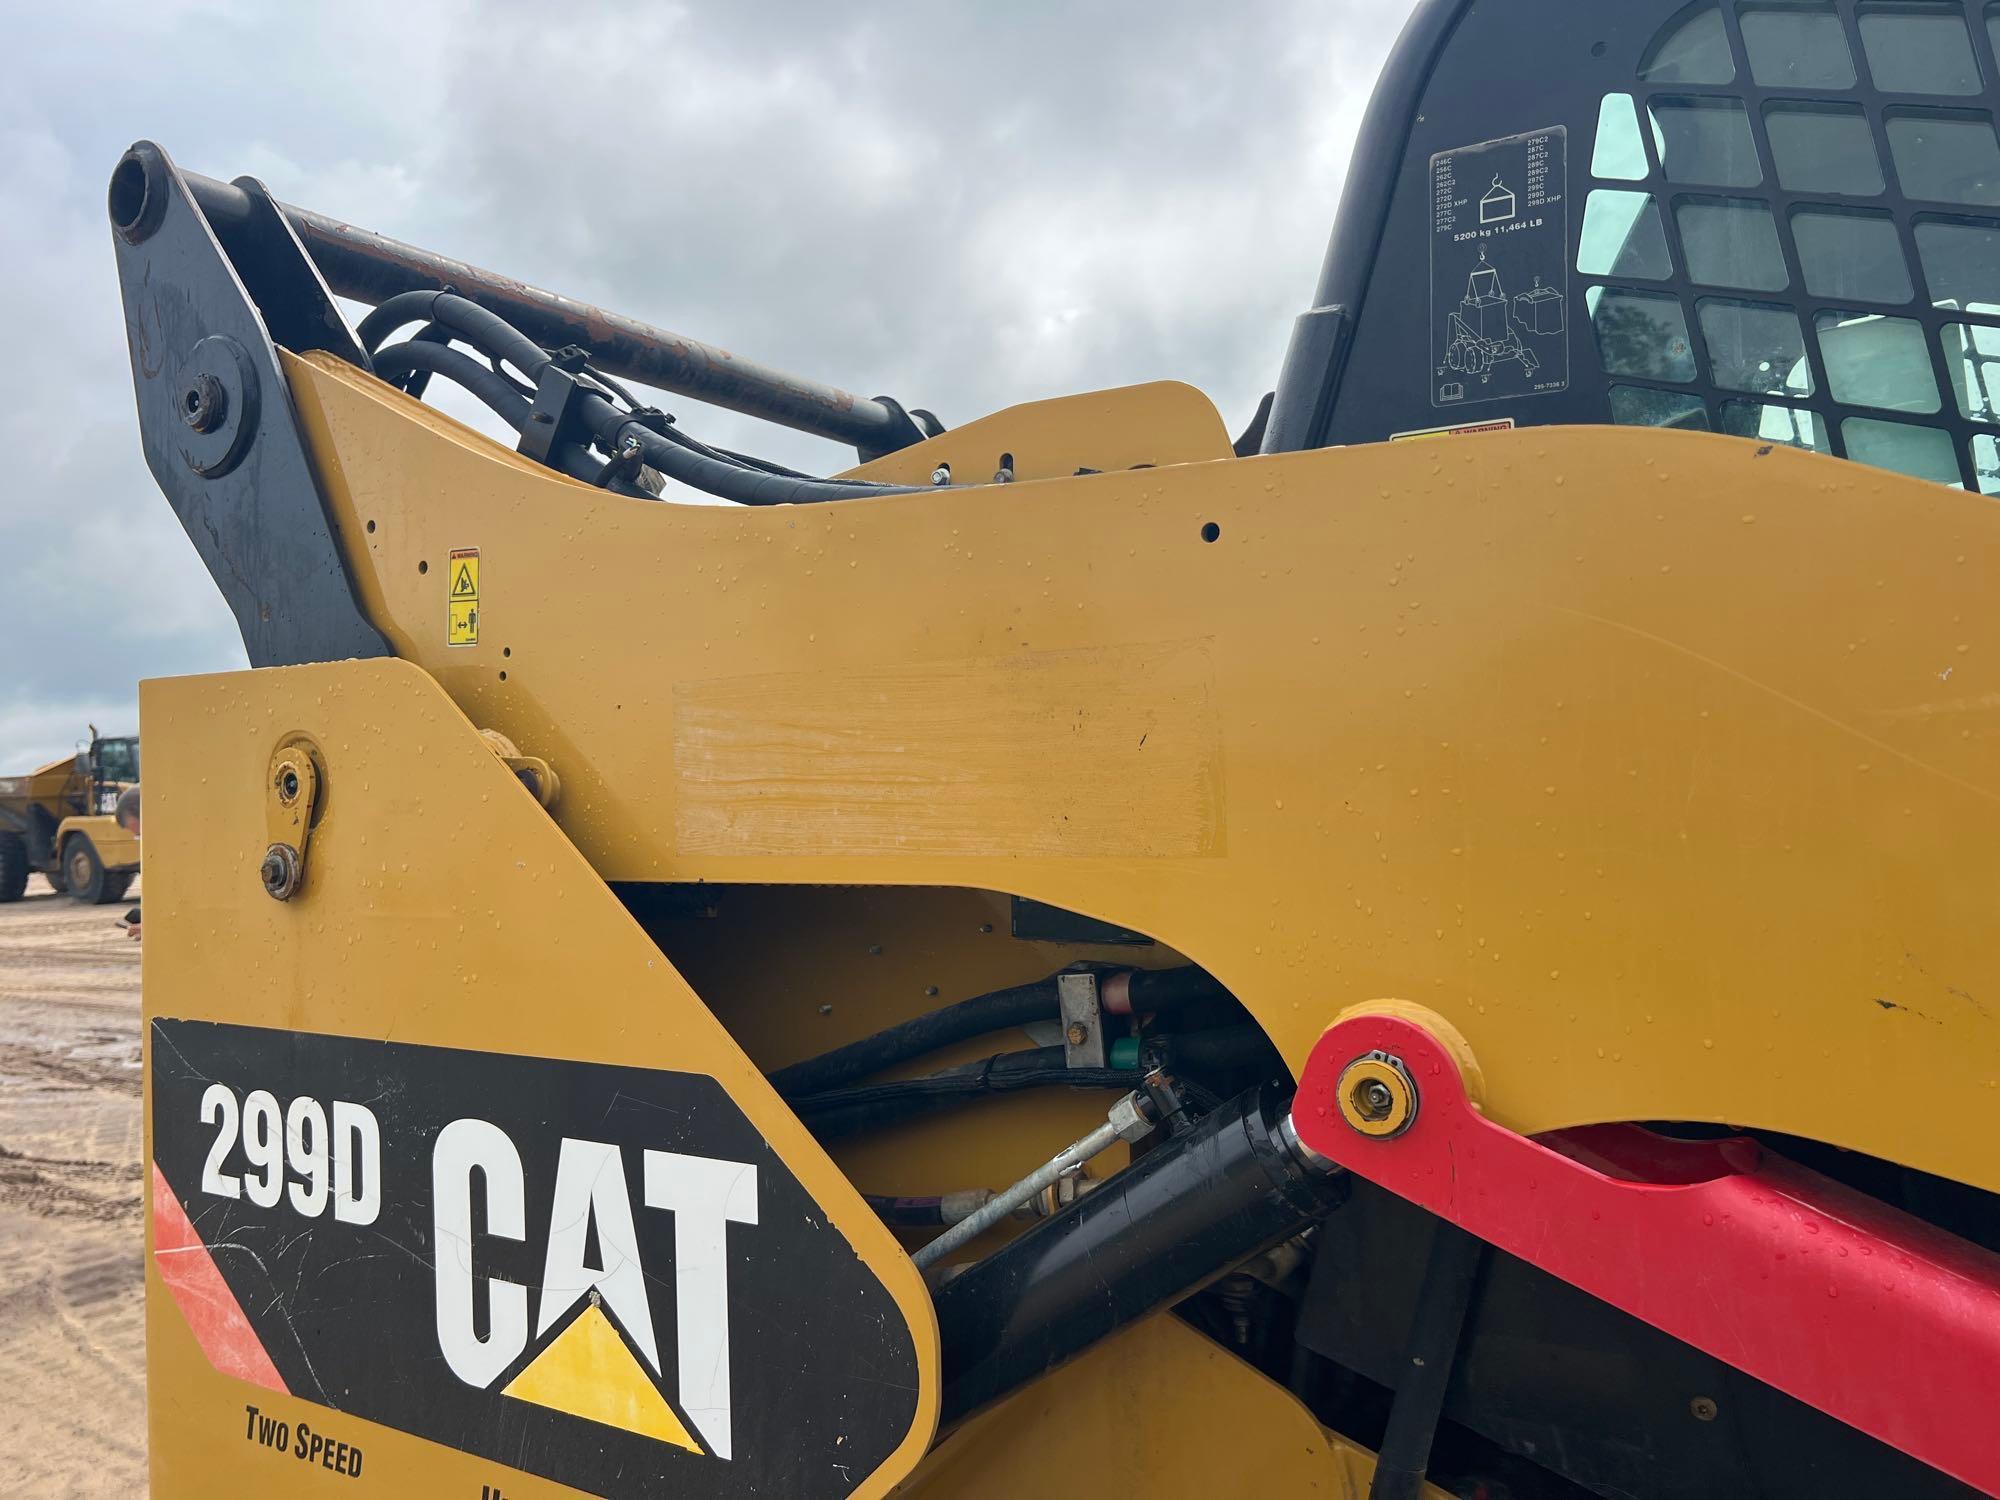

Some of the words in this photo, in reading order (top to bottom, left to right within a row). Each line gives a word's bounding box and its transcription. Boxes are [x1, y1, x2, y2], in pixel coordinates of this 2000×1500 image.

[1528, 145, 1544, 153] 287C
[1528, 152, 1548, 161] 287C2
[1436, 187, 1452, 196] 272C
[1546, 194, 1562, 203] XHP
[1436, 209, 1452, 218] 277C
[1436, 216, 1456, 225] 277C2
[1453, 231, 1477, 242] 5200
[1479, 229, 1491, 237] kg
[1494, 221, 1527, 234] 11,464
[1529, 218, 1543, 227] LB
[201, 1083, 381, 1226] 299D
[432, 1117, 758, 1461] CAT
